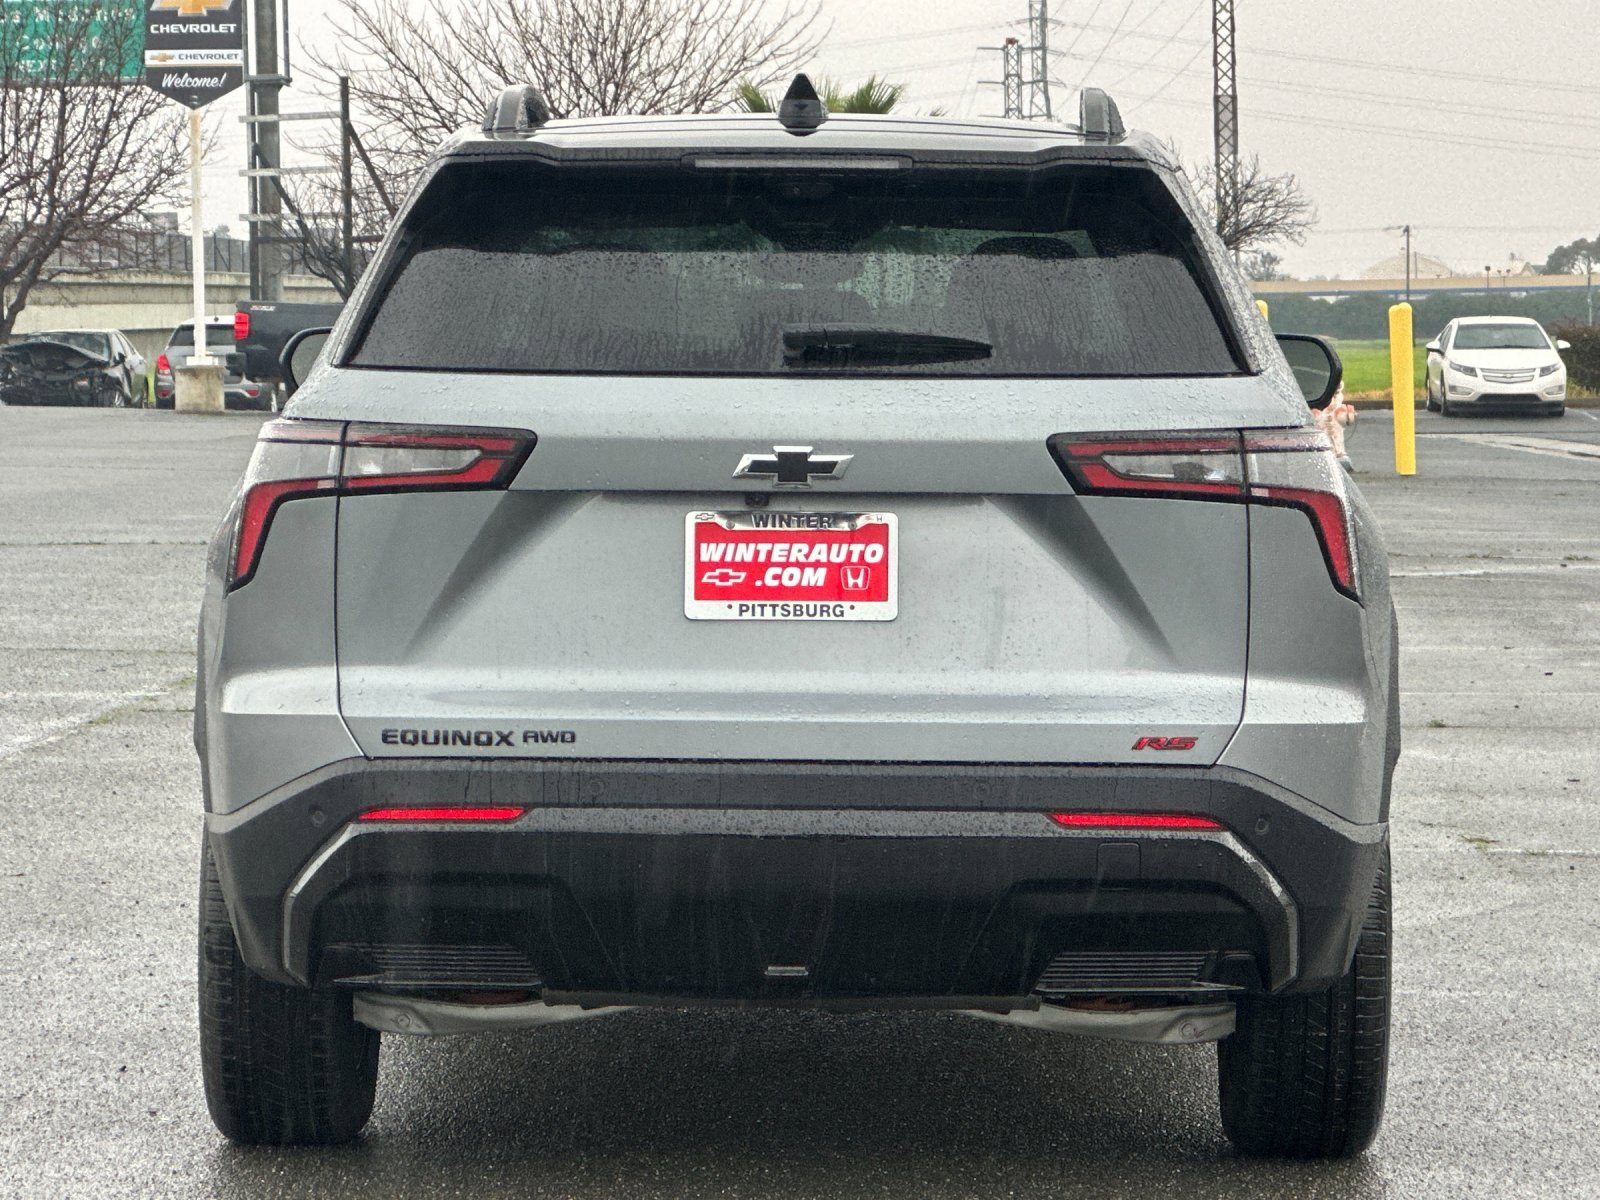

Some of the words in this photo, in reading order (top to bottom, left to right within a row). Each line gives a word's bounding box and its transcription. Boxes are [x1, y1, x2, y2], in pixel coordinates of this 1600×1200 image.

[150, 23, 237, 34] CHEVROLET
[178, 53, 239, 61] CHEVROLET
[161, 72, 227, 88] Welcome!
[751, 513, 833, 529] WINTER
[699, 542, 884, 563] WINTERAUTO
[755, 567, 827, 587] .COM
[738, 603, 845, 618] PITTSBURG
[381, 728, 515, 746] EQUINOX
[522, 730, 576, 744] AWD
[1131, 736, 1199, 751] RS
